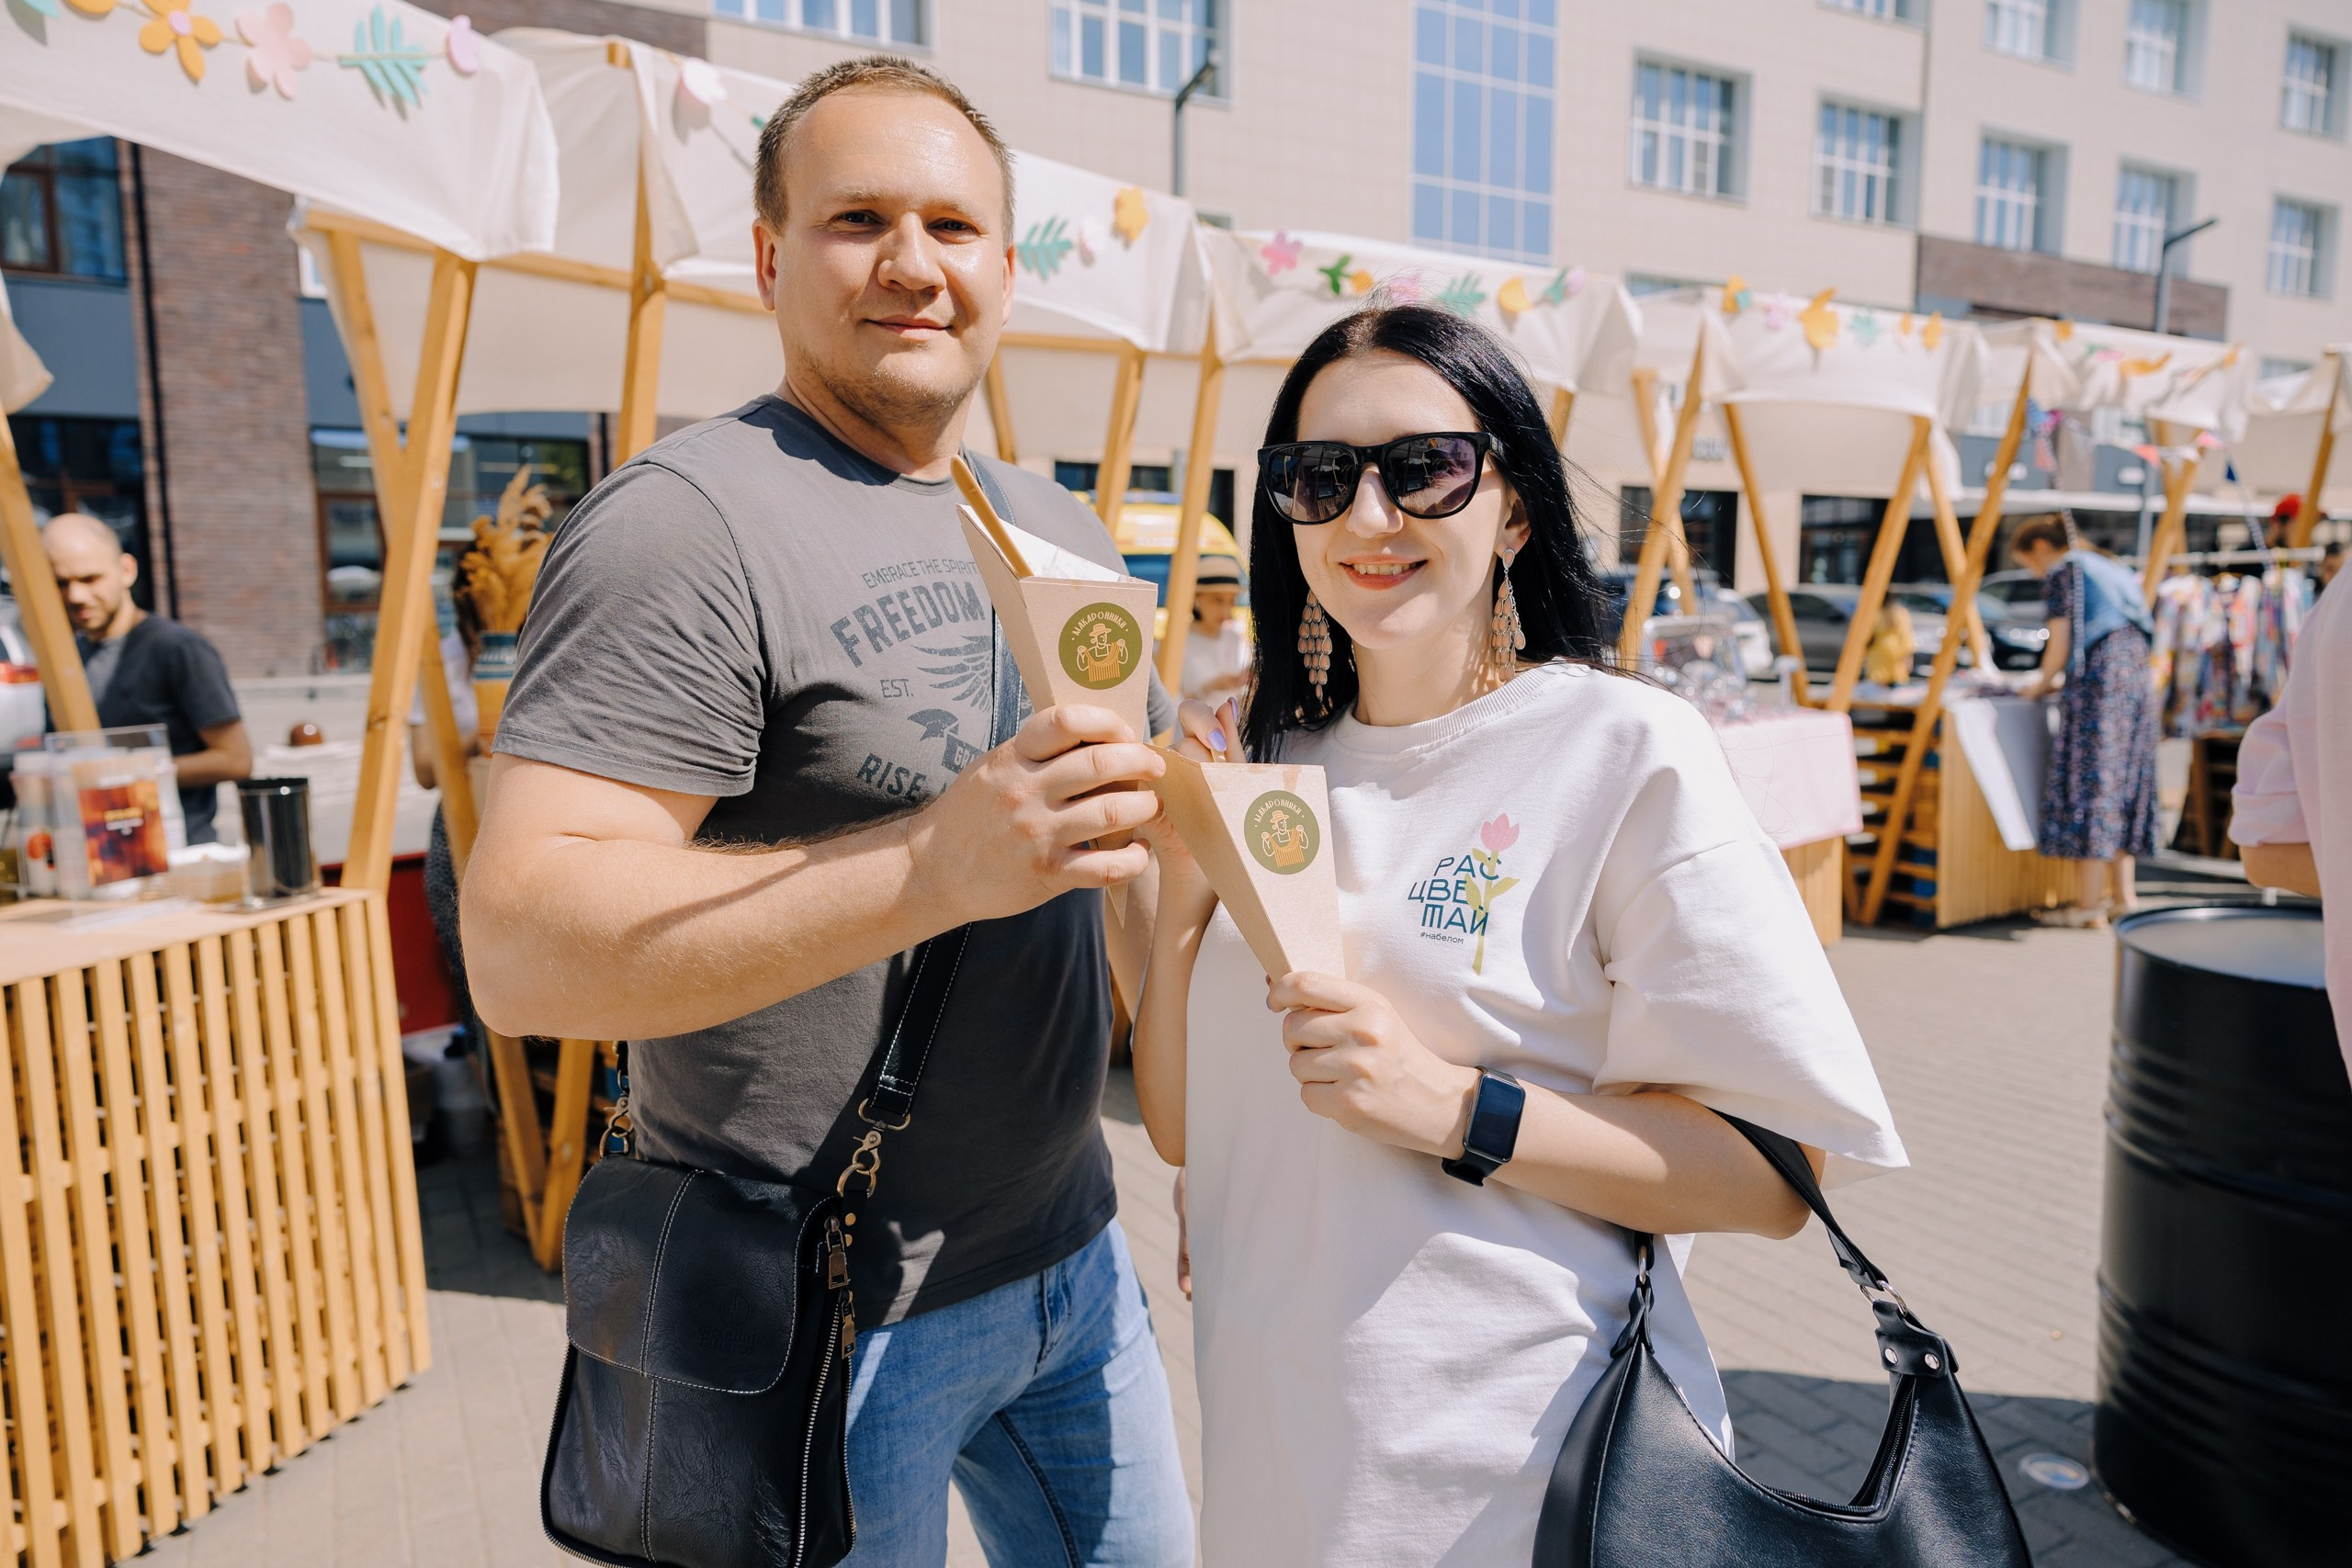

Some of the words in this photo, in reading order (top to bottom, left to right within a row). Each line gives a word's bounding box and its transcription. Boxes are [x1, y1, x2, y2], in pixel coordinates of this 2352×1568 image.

[862, 561, 920, 589] EMBRACE
[916, 558, 942, 576] THE
[943, 558, 978, 575] SPIRIT
[830, 581, 986, 668] FREEDOM
[1072, 611, 1127, 636] МАКАРОННИКИ
[880, 678, 913, 698] EST.
[856, 753, 927, 802] RISE
[1254, 799, 1302, 823] МАКАРОННИКИ
[1433, 855, 1502, 880] РАС
[1408, 878, 1469, 904] ЦВЕ
[1420, 932, 1464, 944] #набелом
